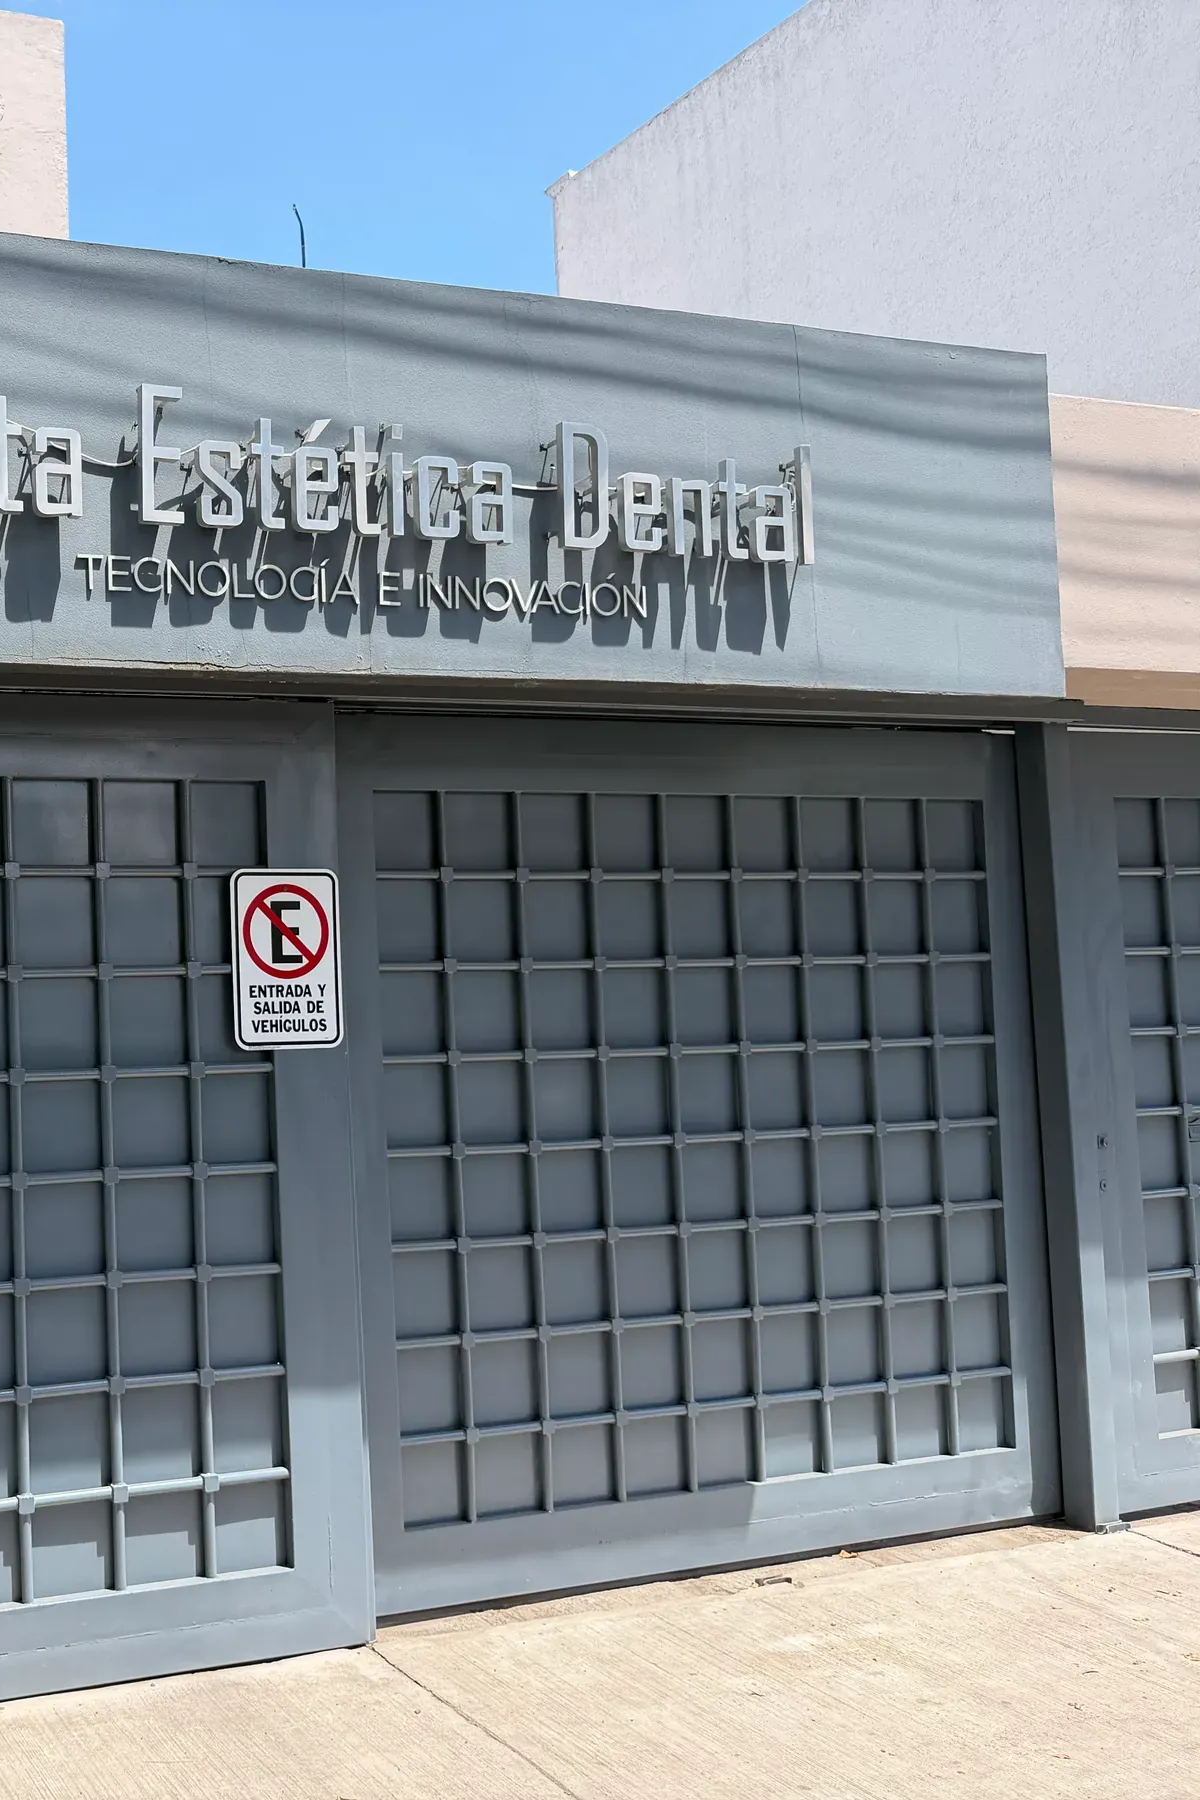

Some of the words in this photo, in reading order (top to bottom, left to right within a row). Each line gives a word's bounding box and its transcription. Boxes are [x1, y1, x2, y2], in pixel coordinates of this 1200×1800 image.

[137, 383, 513, 545] Estética
[556, 422, 815, 565] Dental
[76, 553, 360, 605] TECNOLOGÍA
[379, 571, 402, 607] E
[419, 572, 648, 619] INNOVACIÓN
[270, 900, 303, 964] E
[249, 984, 312, 998] ENTRADA
[317, 984, 327, 997] Y
[253, 1001, 301, 1014] SALIDA
[307, 1000, 324, 1013] DE
[251, 1016, 327, 1033] VEHÍCULOS
